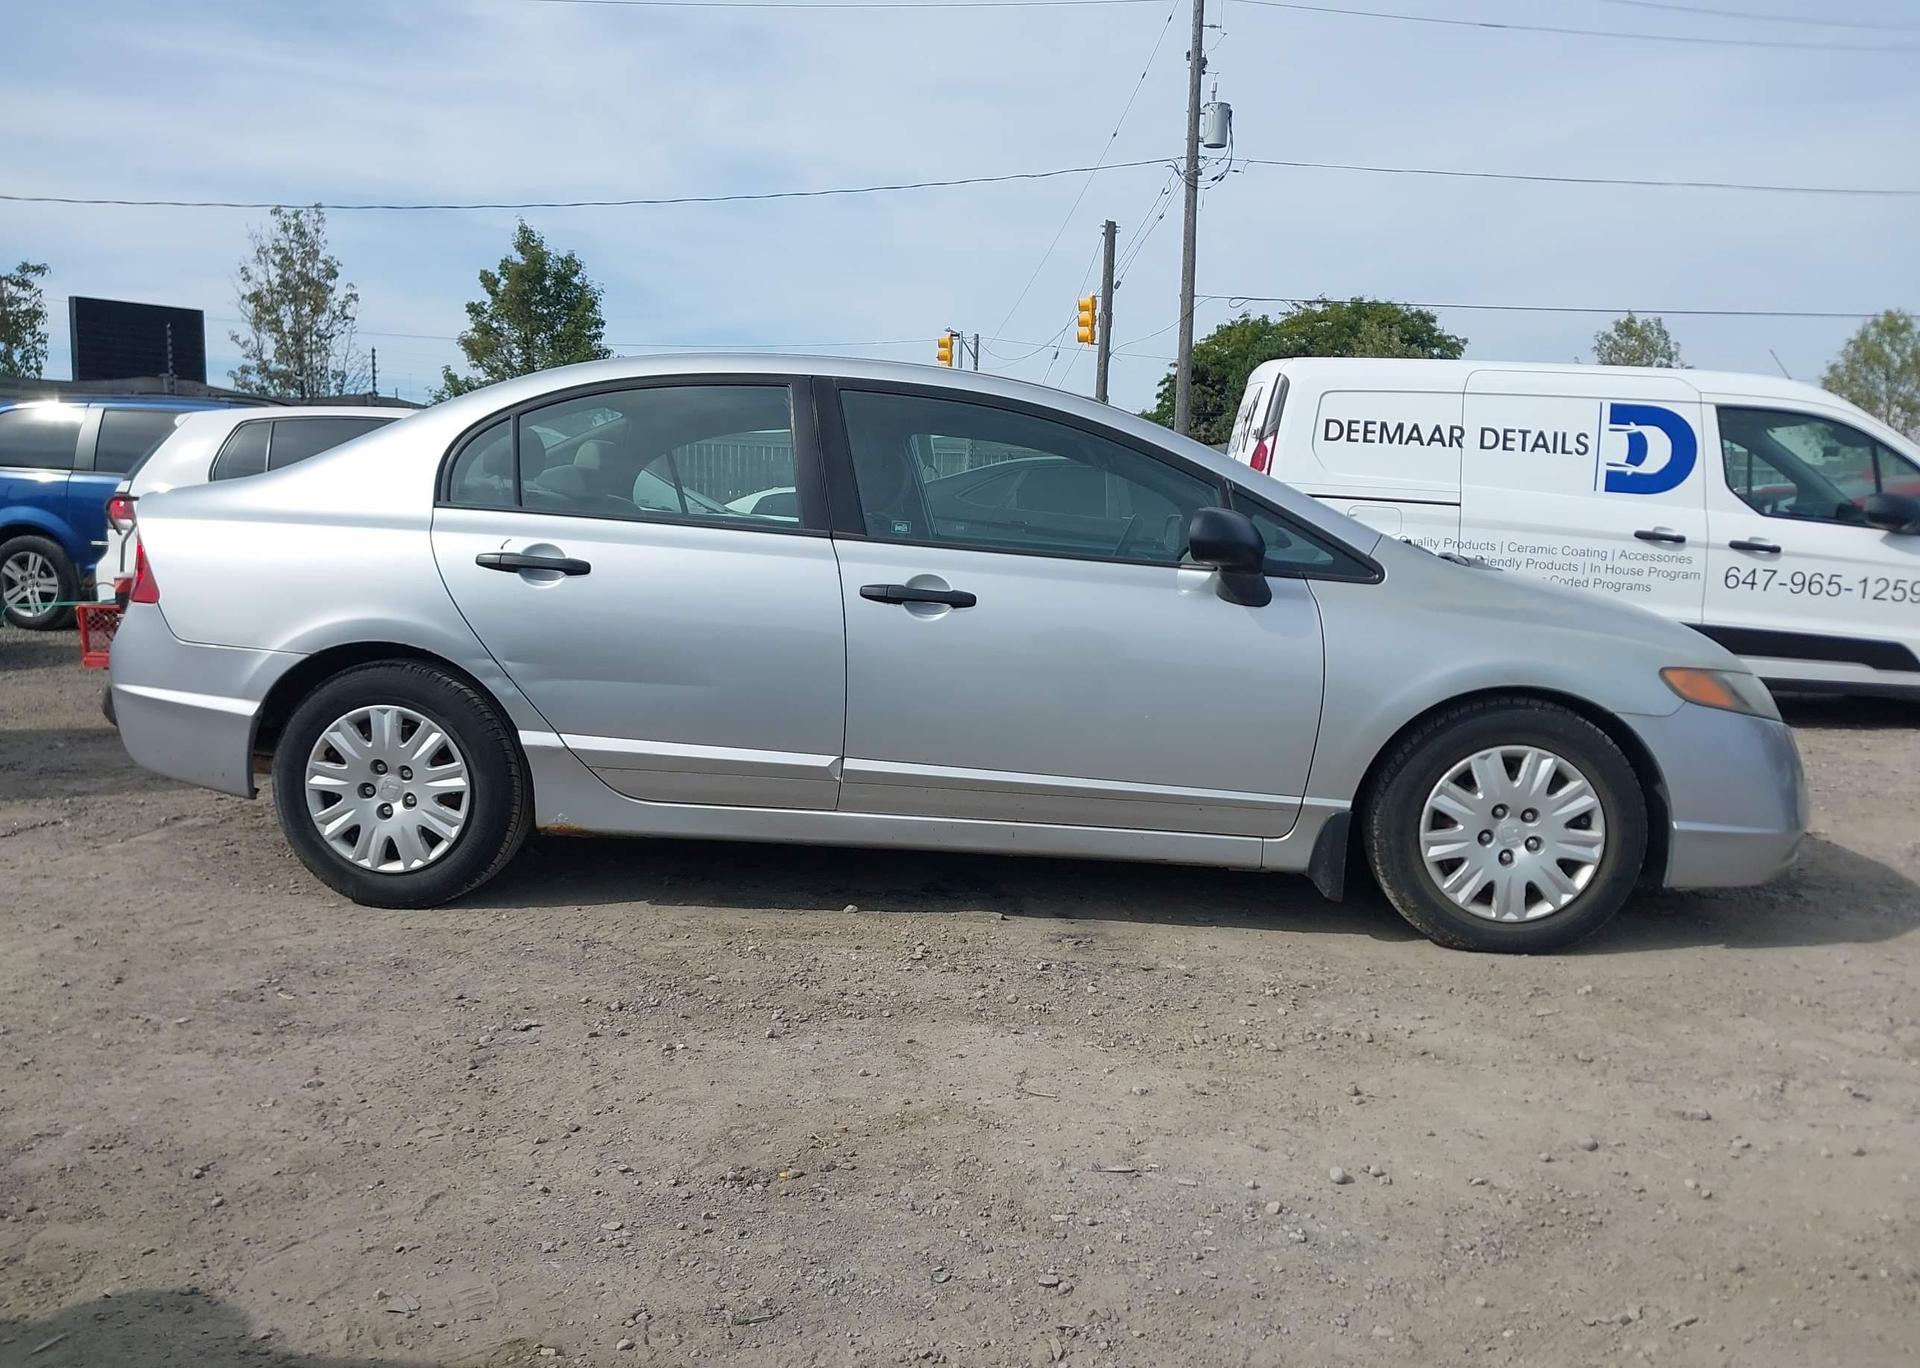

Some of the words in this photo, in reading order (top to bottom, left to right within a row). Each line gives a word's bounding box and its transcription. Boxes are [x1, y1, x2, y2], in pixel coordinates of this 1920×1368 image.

[1323, 418, 1466, 449] DEEMAAR
[1479, 426, 1590, 457] DETAILS
[1443, 537, 1497, 552] Products
[1507, 541, 1558, 556] Ceramic
[1561, 545, 1608, 561] Coating
[1618, 549, 1694, 565] Accessories
[1525, 558, 1579, 573] Products
[1590, 562, 1601, 574] In
[1604, 564, 1645, 577] House
[1647, 566, 1702, 582] Program
[1592, 578, 1652, 593] Programs
[1724, 566, 1920, 604] 647-965-1259
